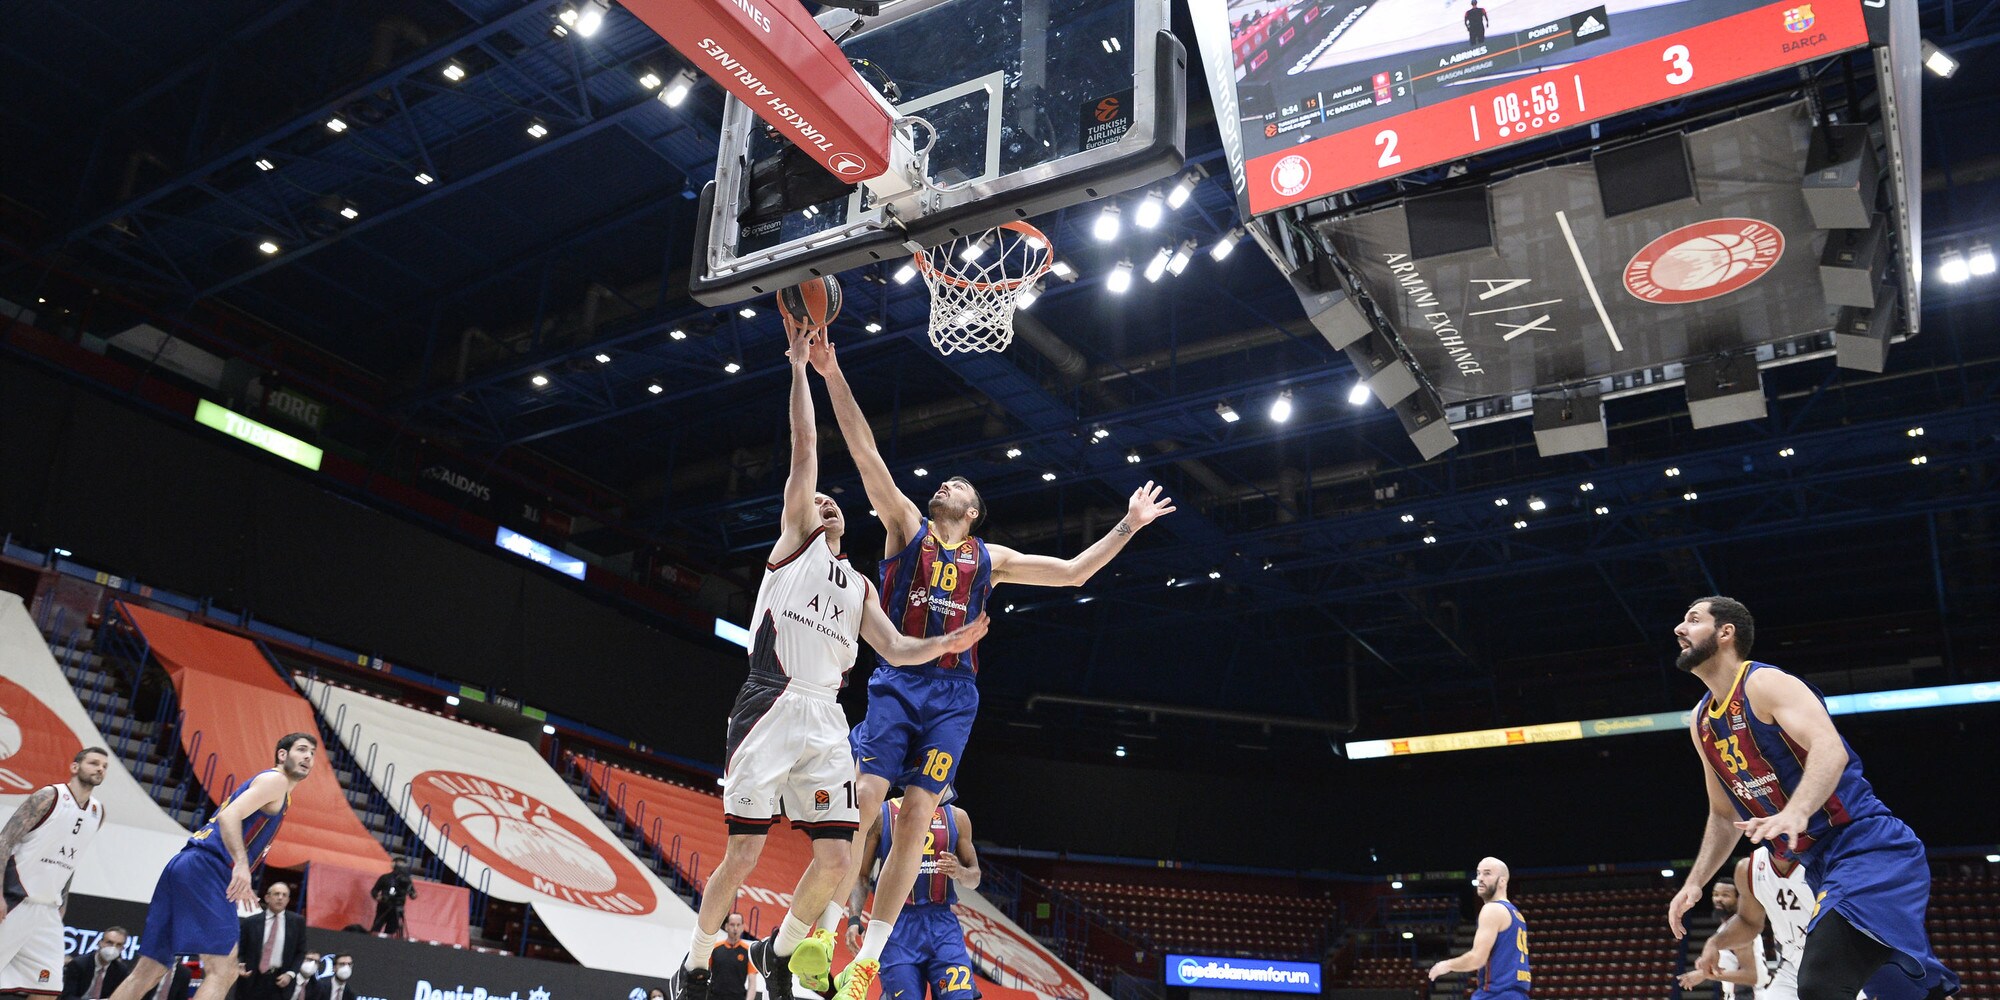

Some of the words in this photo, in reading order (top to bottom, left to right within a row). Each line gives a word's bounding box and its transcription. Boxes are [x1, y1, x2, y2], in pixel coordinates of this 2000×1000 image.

[1528, 24, 1559, 39] POINTS
[1782, 33, 1828, 53] BARÇA
[1450, 46, 1487, 64] ABRINES
[1539, 41, 1554, 52] 7.9
[697, 38, 774, 97] AIRLINES
[1395, 71, 1403, 81] 2
[1437, 69, 1463, 83] SEASON
[1464, 61, 1494, 75] AVERAGE
[1663, 45, 1694, 85] 3
[1343, 85, 1363, 97] MILAN
[1398, 87, 1405, 96] 3
[1265, 112, 1276, 120] 1ST
[1282, 104, 1298, 116] 8:54
[1307, 99, 1316, 108] 15
[1327, 108, 1335, 117] FC
[1336, 97, 1372, 113] BARCELONA
[1493, 81, 1559, 126] 08:53
[767, 97, 834, 152] TURKISH
[1087, 125, 1127, 143] AIRLINES
[1088, 117, 1127, 135] TURKISH
[1085, 135, 1123, 150] EuroLeagu
[1375, 129, 1401, 168] 2
[1740, 223, 1778, 270] OLIMPIA
[1629, 261, 1663, 299] MILANO
[1383, 253, 1439, 308] ARMANI
[1425, 311, 1485, 377] EXCHANGE
[225, 411, 298, 460] TUBO
[828, 560, 848, 589] 10
[931, 561, 958, 592] 18
[928, 594, 967, 612] Assistència
[781, 609, 815, 628] ARMANI
[923, 748, 953, 782] 18
[1714, 735, 1748, 774] 33
[428, 774, 552, 820] OLIMPIA
[72, 818, 83, 835] 5
[923, 831, 935, 855] 2
[533, 876, 645, 914] MILANO
[1776, 888, 1801, 911] 42
[946, 966, 972, 991] 22
[1181, 961, 1310, 984] mediolanumforum
